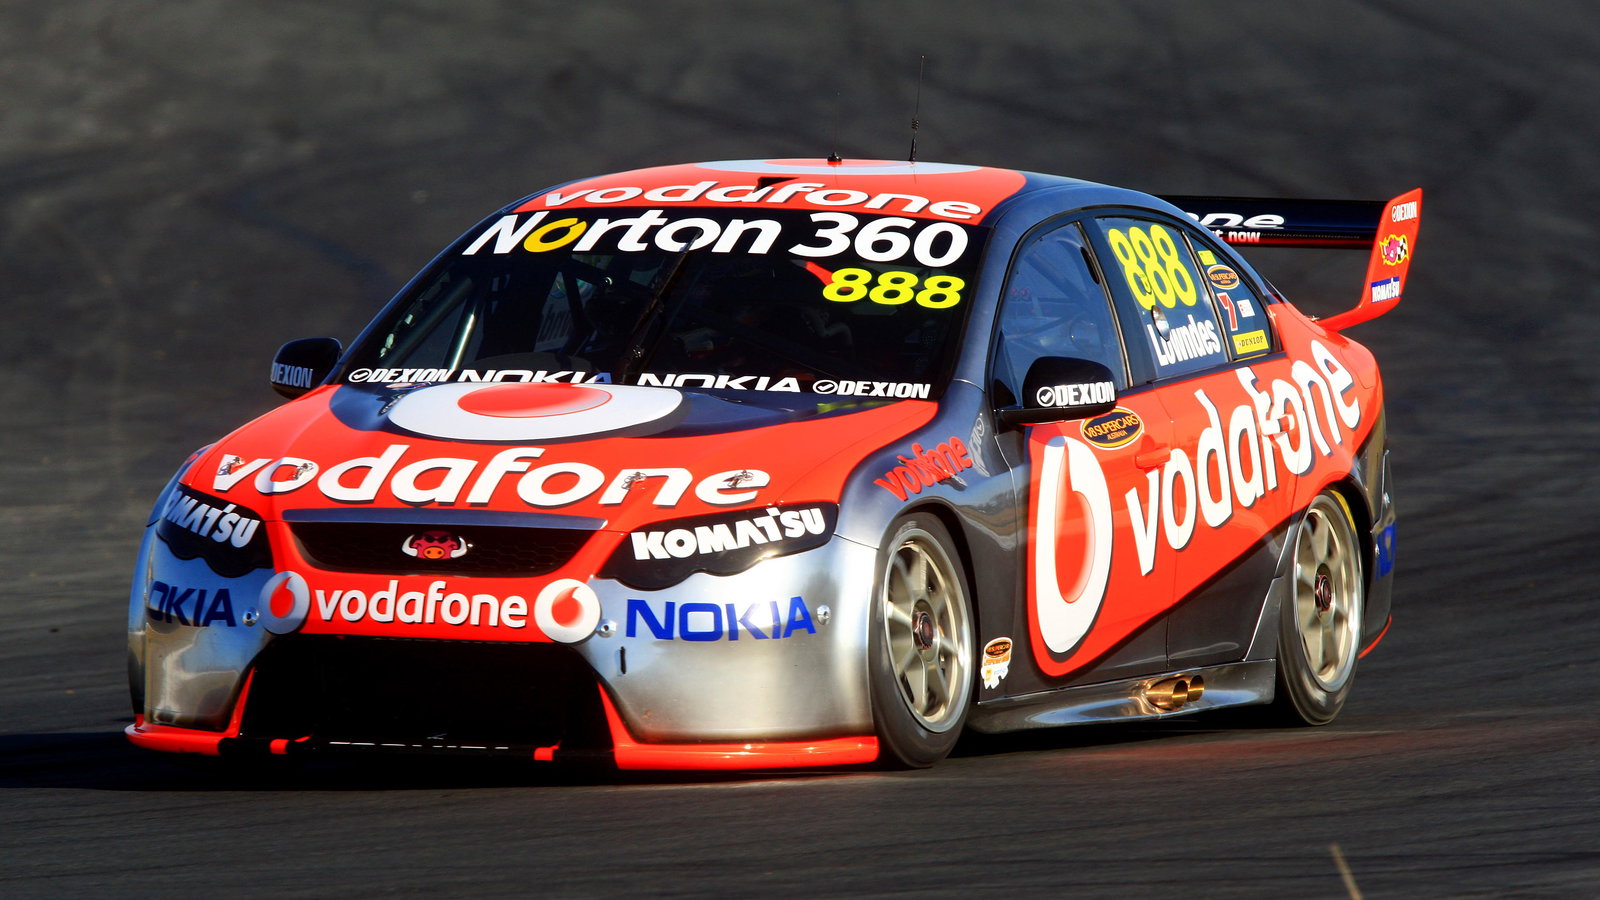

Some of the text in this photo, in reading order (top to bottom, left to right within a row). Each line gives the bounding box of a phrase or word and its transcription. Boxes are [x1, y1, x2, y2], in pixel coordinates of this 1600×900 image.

[545, 180, 982, 219] vodafone
[461, 209, 969, 268] Norton 360
[1228, 231, 1260, 243] now
[821, 267, 965, 309] 888
[1107, 224, 1197, 311] 888
[1146, 314, 1221, 367] Lowndes
[368, 368, 454, 383] DEXION
[457, 369, 612, 384] NOKIA
[636, 372, 801, 392] NOKIA
[836, 380, 931, 399] DEXION
[1054, 381, 1115, 406] DEXION
[212, 444, 770, 507] vodafone
[1125, 340, 1361, 577] vodafone
[163, 490, 261, 548] OMATSU
[631, 507, 826, 561] KOMATSU
[147, 580, 237, 627] OKIA
[314, 579, 528, 628] vodafone
[626, 596, 817, 642] NOKIA
